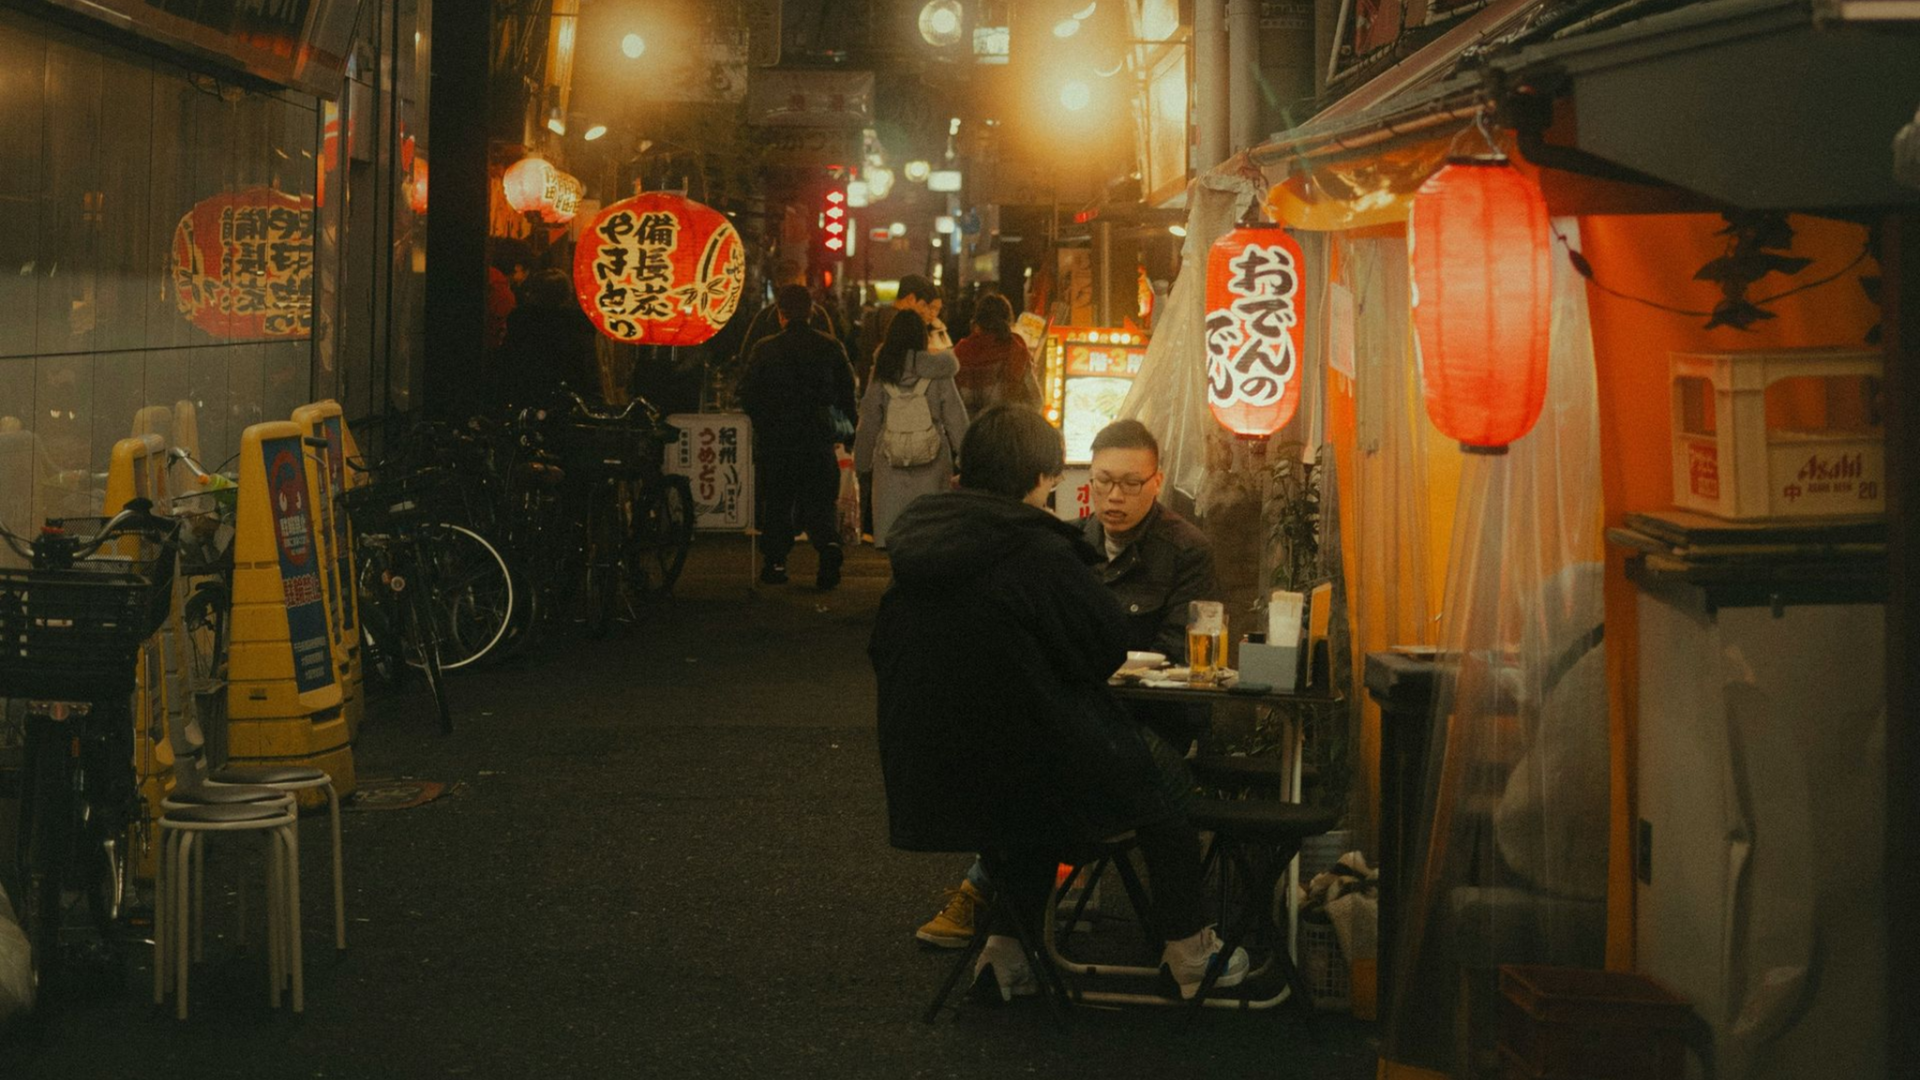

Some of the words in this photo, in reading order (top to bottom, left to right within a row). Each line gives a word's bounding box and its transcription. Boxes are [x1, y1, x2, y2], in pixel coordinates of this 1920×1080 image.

[628, 213, 676, 317] 備長炭
[1233, 250, 1293, 400] おでんの
[698, 427, 716, 501] うめどり
[719, 427, 738, 465] 紀州
[1797, 452, 1862, 480] Asahi
[1784, 483, 1802, 502] 中
[1859, 481, 1877, 499] 20
